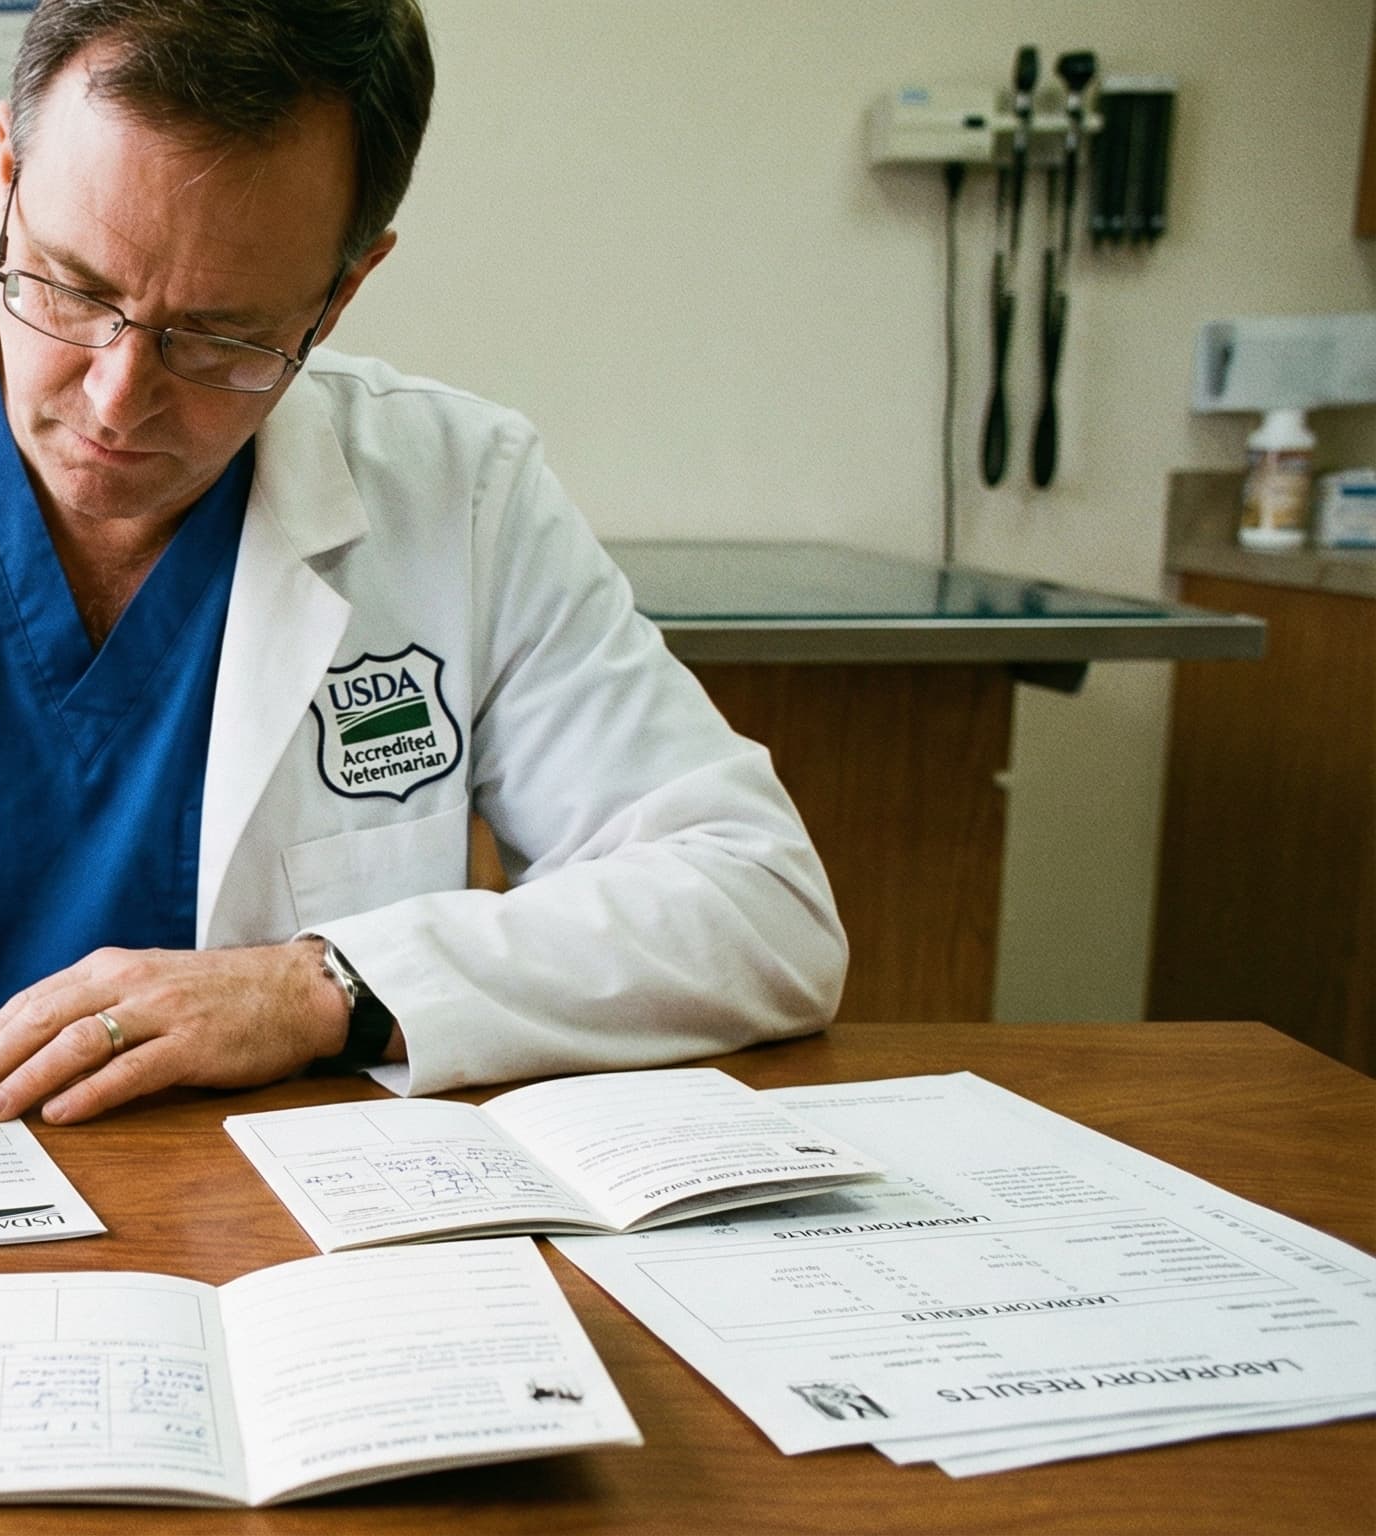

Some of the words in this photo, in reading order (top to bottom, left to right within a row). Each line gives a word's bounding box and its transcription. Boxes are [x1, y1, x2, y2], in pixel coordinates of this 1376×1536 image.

[328, 667, 422, 711] USDA
[343, 731, 437, 767] Accredited
[340, 752, 448, 787] Veterinarian
[901, 1307, 989, 1322] RESULTS
[1092, 1357, 1305, 1389] LABORATORY
[936, 1377, 1087, 1403] RESULTS
